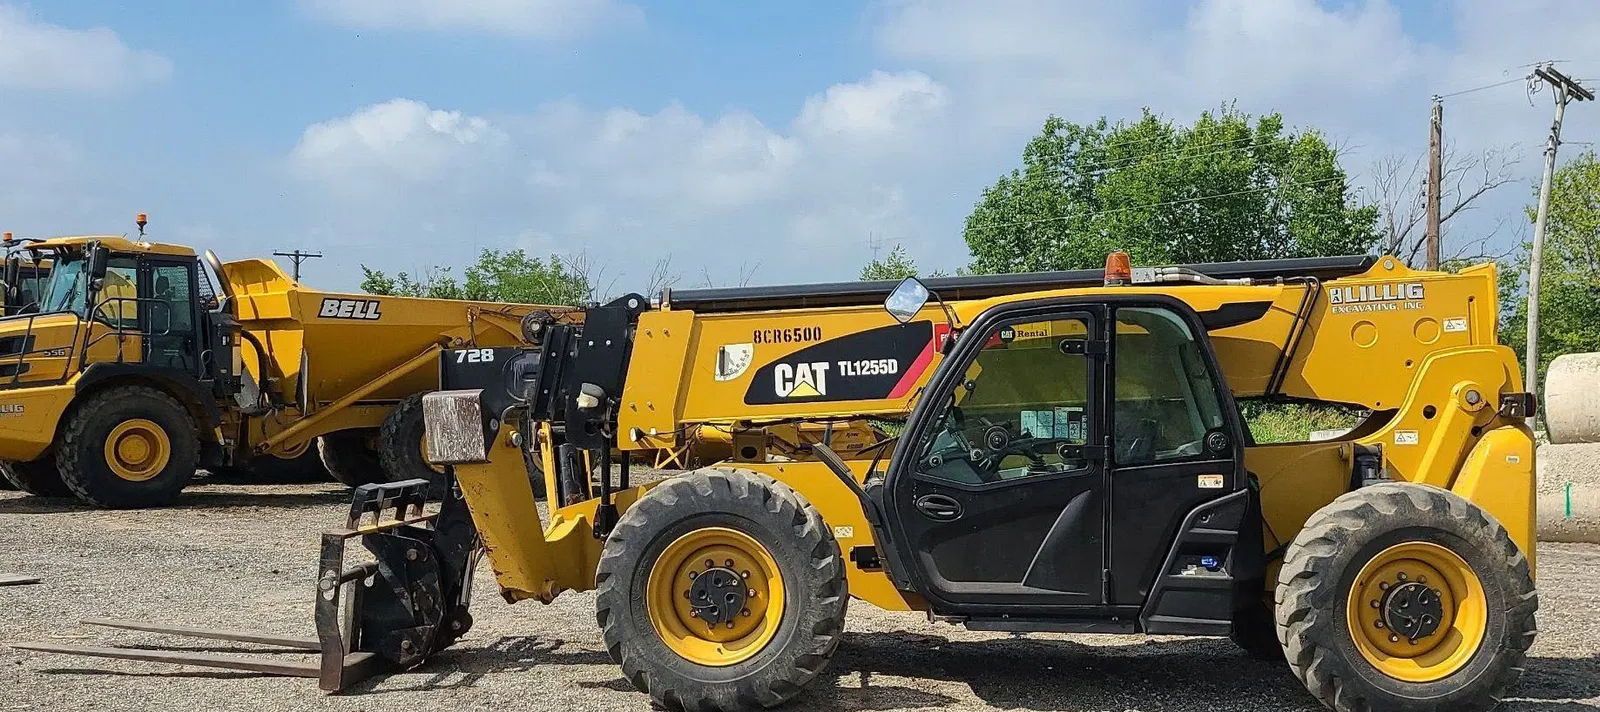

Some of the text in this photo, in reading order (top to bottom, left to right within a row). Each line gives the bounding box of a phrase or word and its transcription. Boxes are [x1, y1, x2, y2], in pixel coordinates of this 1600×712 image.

[1345, 283, 1425, 303] LILLIG
[318, 298, 382, 320] BELL
[1332, 301, 1425, 314] EXCAVATING, INC.
[753, 327, 822, 344] 8CR6500
[1001, 329, 1048, 339] CAT Rental
[454, 348, 494, 363] 728
[774, 361, 829, 398] CAT
[837, 358, 898, 377] TL1255D
[0, 404, 24, 413] LIG
